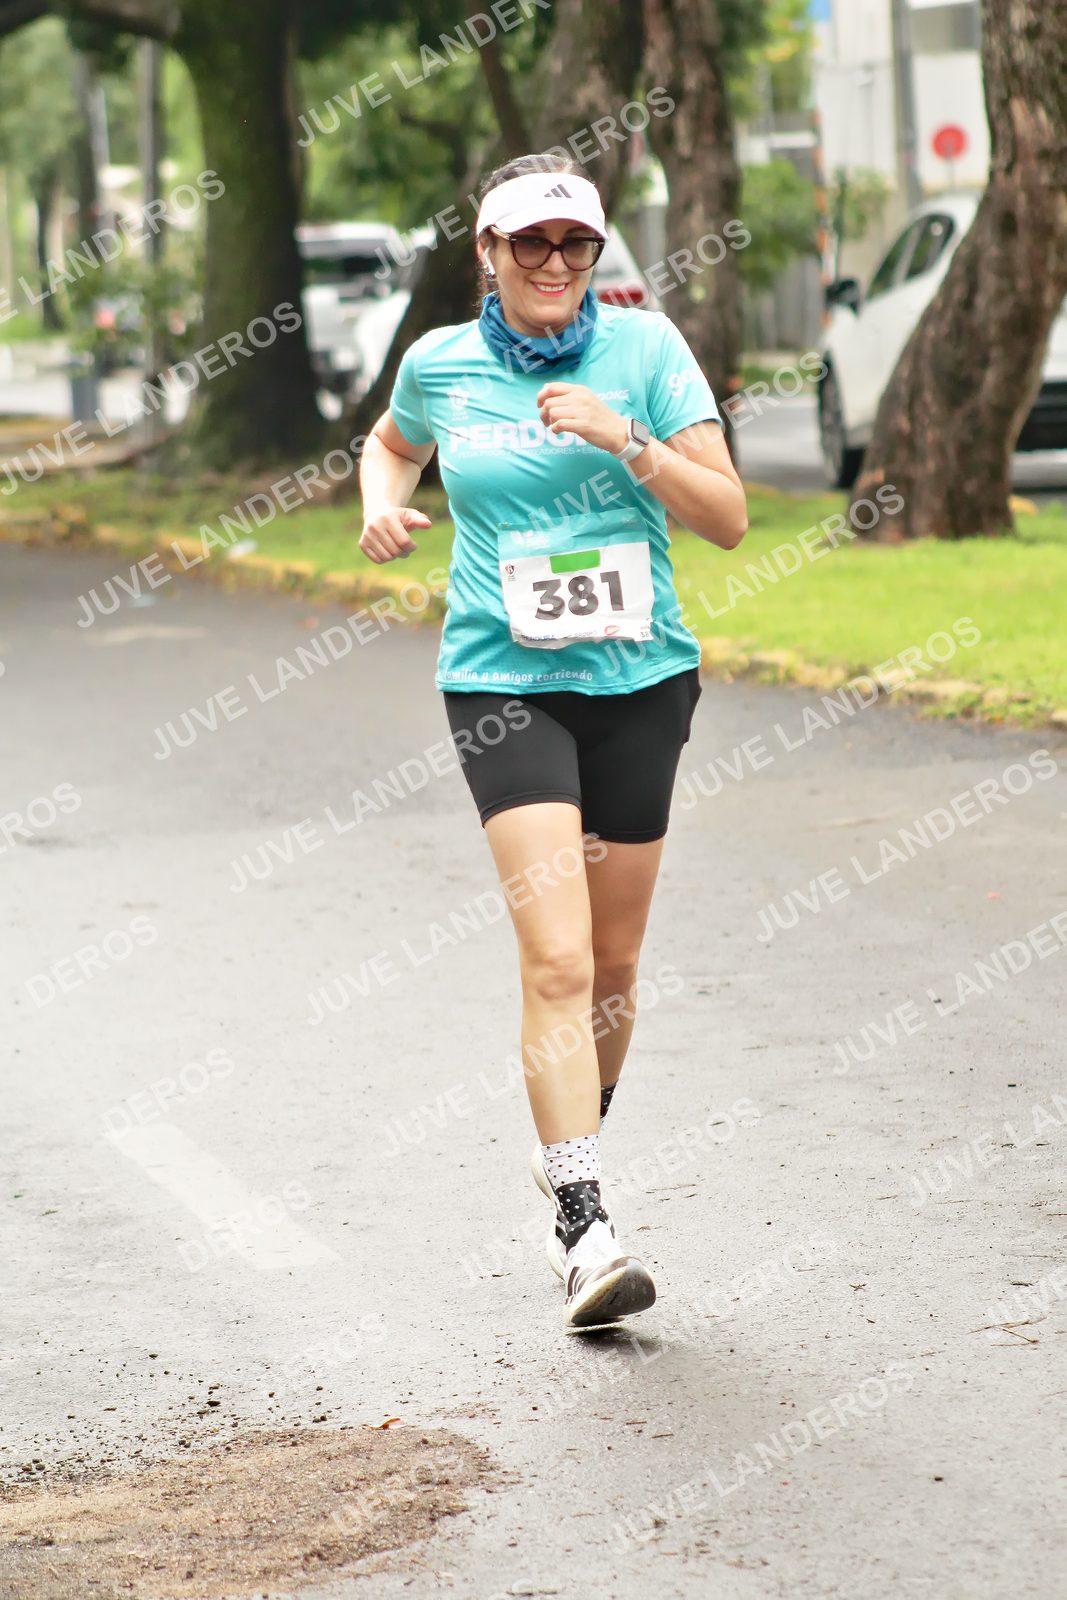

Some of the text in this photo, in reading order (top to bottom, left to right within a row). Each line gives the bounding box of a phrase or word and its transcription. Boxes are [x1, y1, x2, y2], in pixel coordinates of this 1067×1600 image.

[532, 571, 625, 620] 381
[480, 673, 489, 684] y
[492, 670, 533, 685] amigos
[536, 669, 593, 682] corriendo
